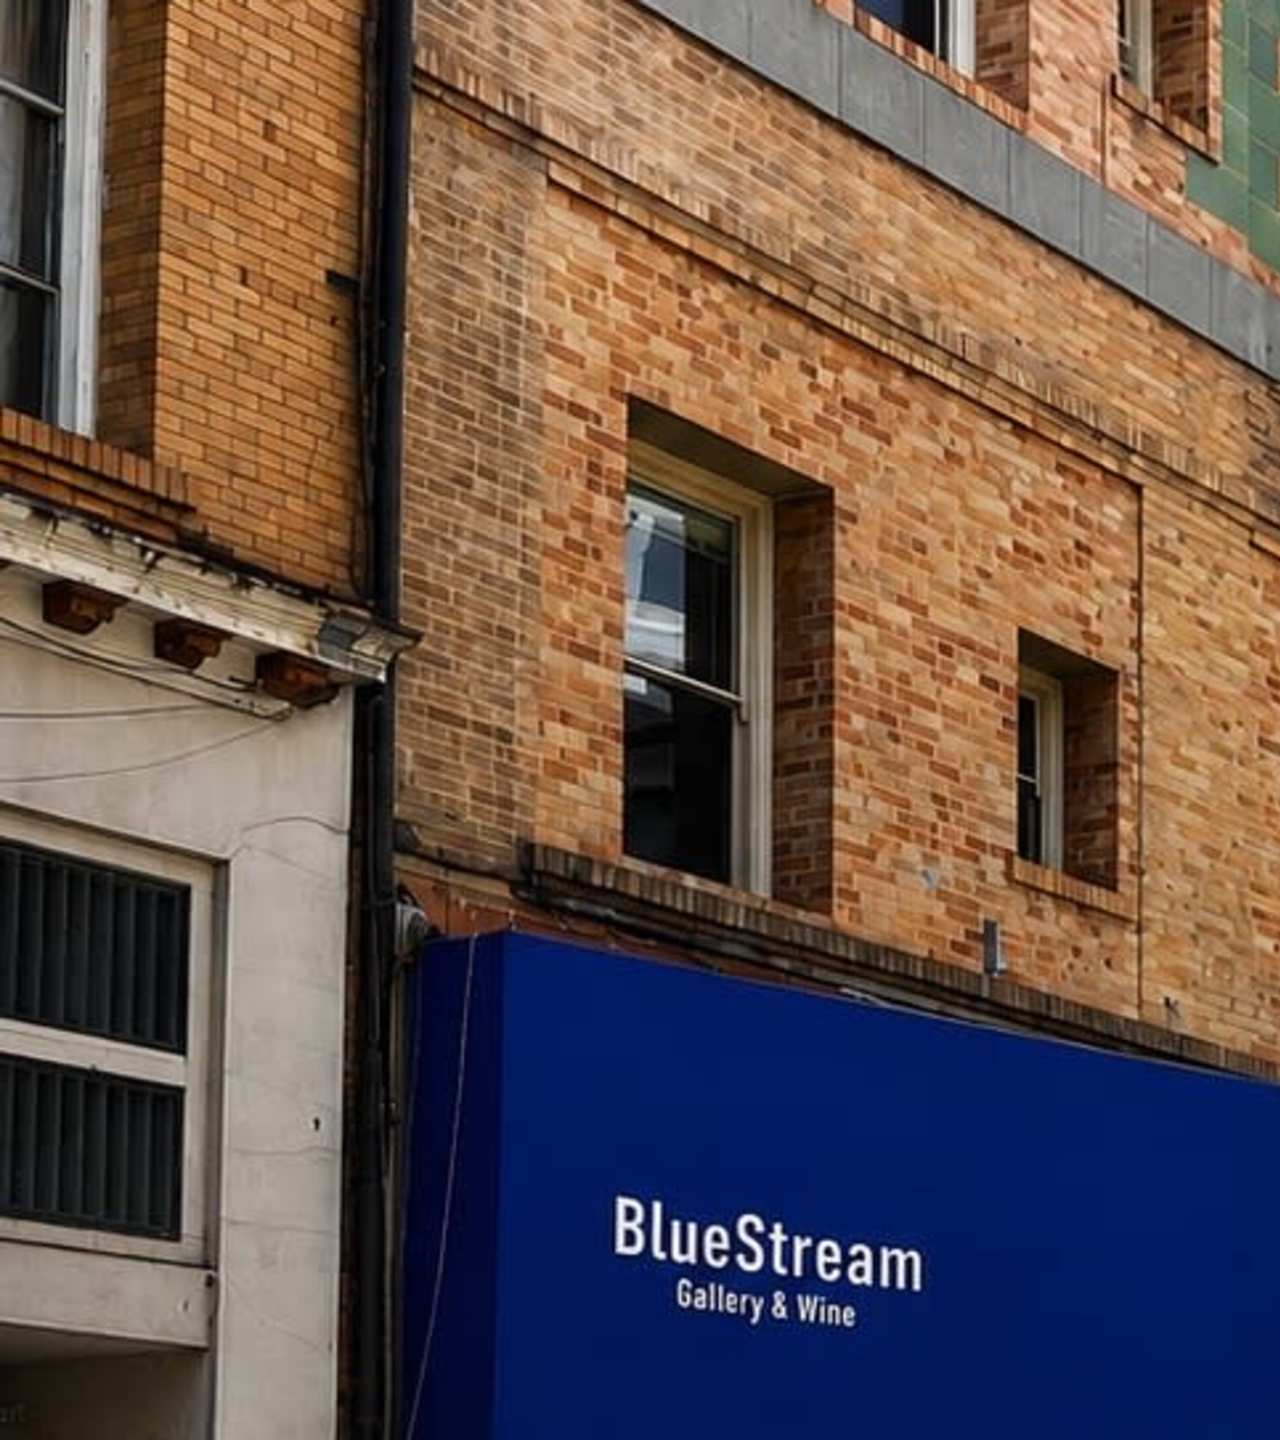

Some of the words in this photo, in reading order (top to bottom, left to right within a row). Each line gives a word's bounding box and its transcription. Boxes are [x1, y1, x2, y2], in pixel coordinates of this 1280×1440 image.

[614, 1195, 923, 1292] BlueStream
[677, 1278, 764, 1325] Gallery
[771, 1291, 788, 1320] &
[798, 1295, 856, 1328] Wine
